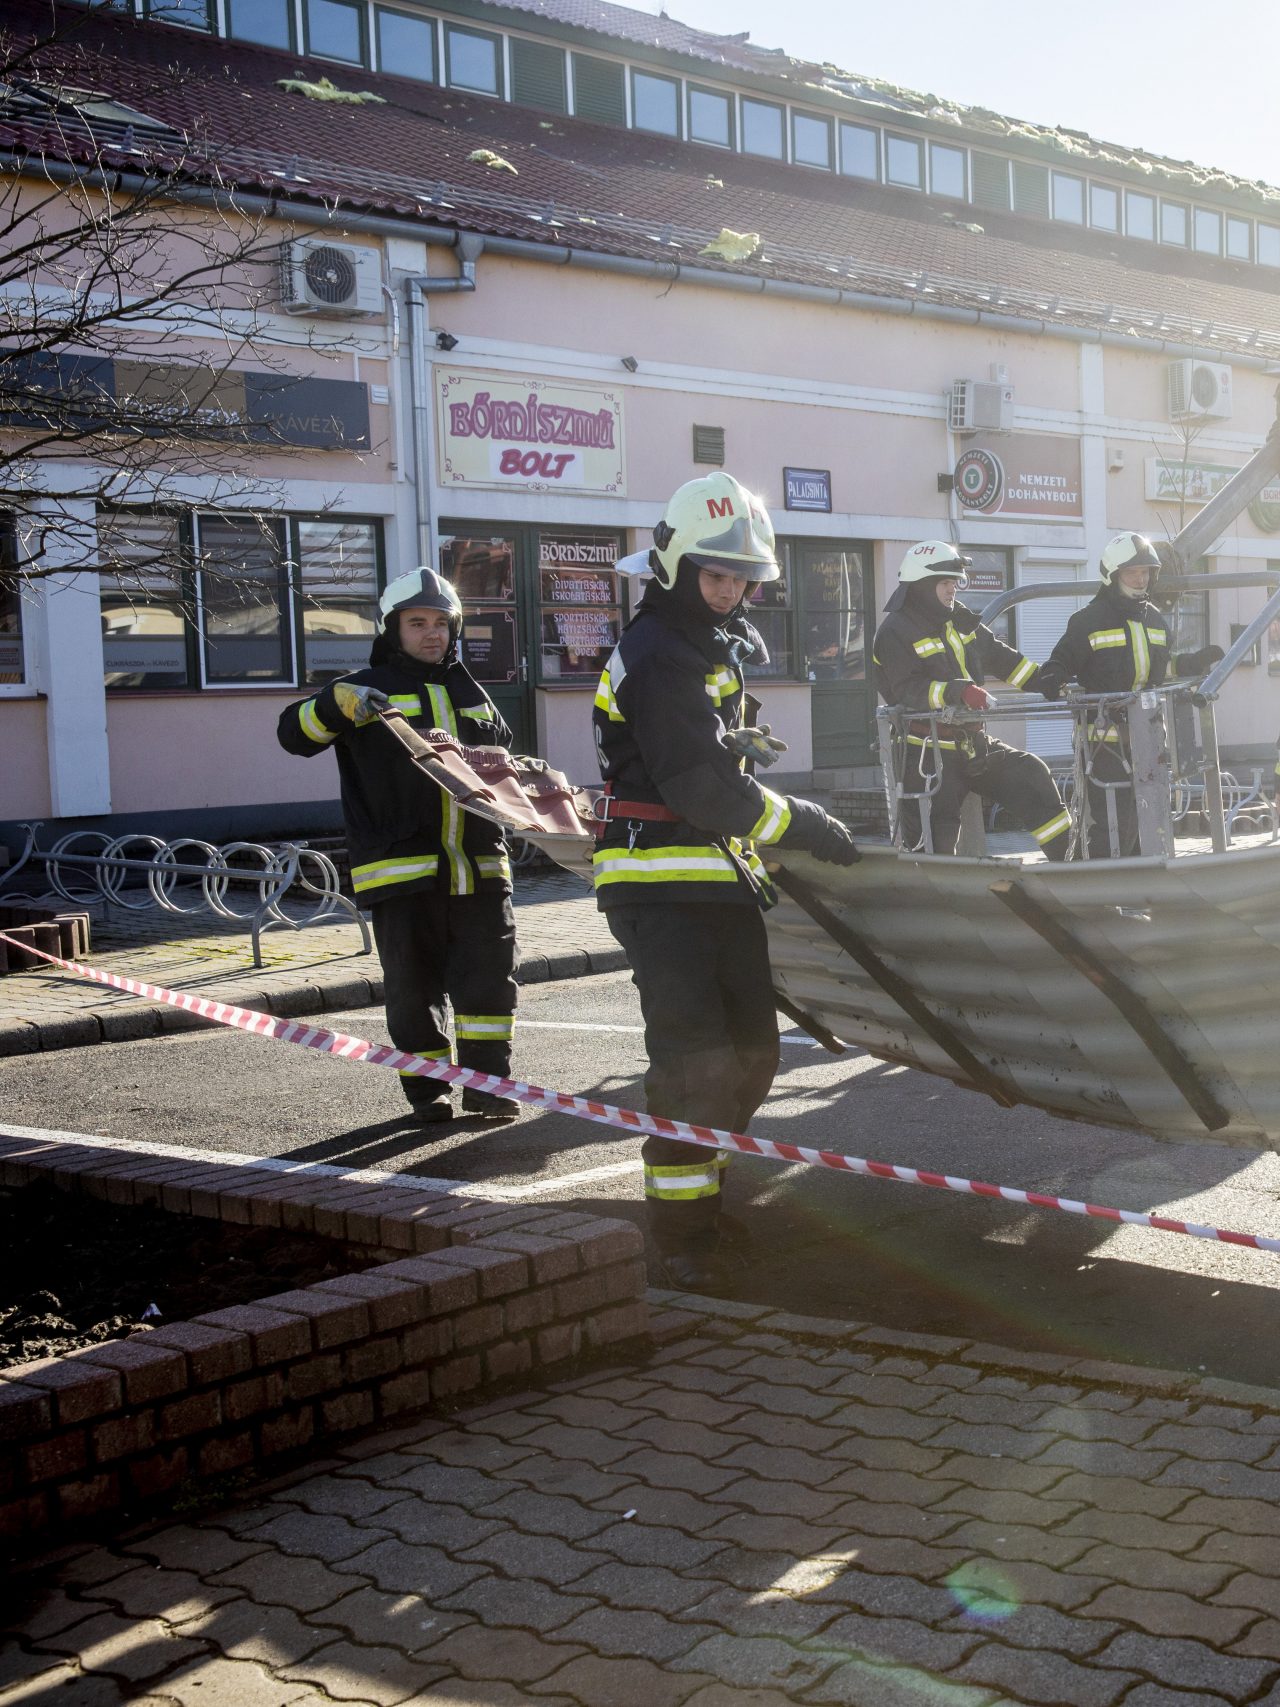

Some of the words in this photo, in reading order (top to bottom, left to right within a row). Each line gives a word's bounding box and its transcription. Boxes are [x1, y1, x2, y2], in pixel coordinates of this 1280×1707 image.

[449, 392, 615, 449] BŐRDÍSZMŰ
[499, 449, 576, 479] BOLT
[968, 474, 977, 484] T
[1019, 474, 1067, 487] NEMZETI
[788, 481, 828, 499] PALACSINTA
[1008, 487, 1077, 503] DOHÁNYBOLT
[706, 496, 734, 519] M
